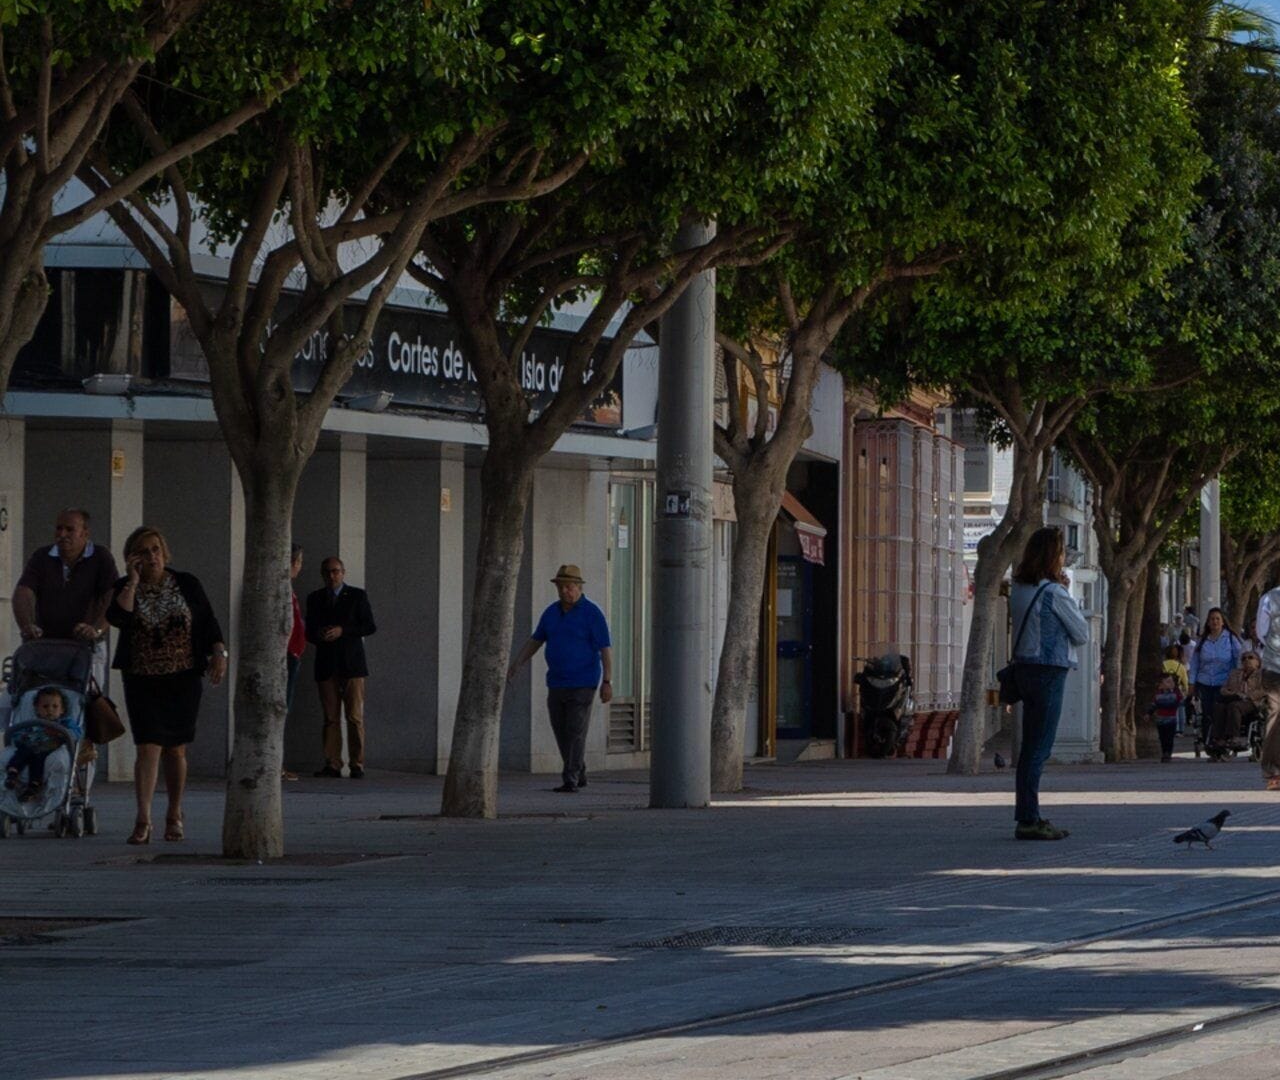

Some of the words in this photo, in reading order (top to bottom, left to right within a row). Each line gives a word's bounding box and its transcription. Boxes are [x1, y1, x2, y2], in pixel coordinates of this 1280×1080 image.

[387, 330, 439, 377] Cortes
[442, 339, 464, 381] de
[521, 350, 546, 392] Isla
